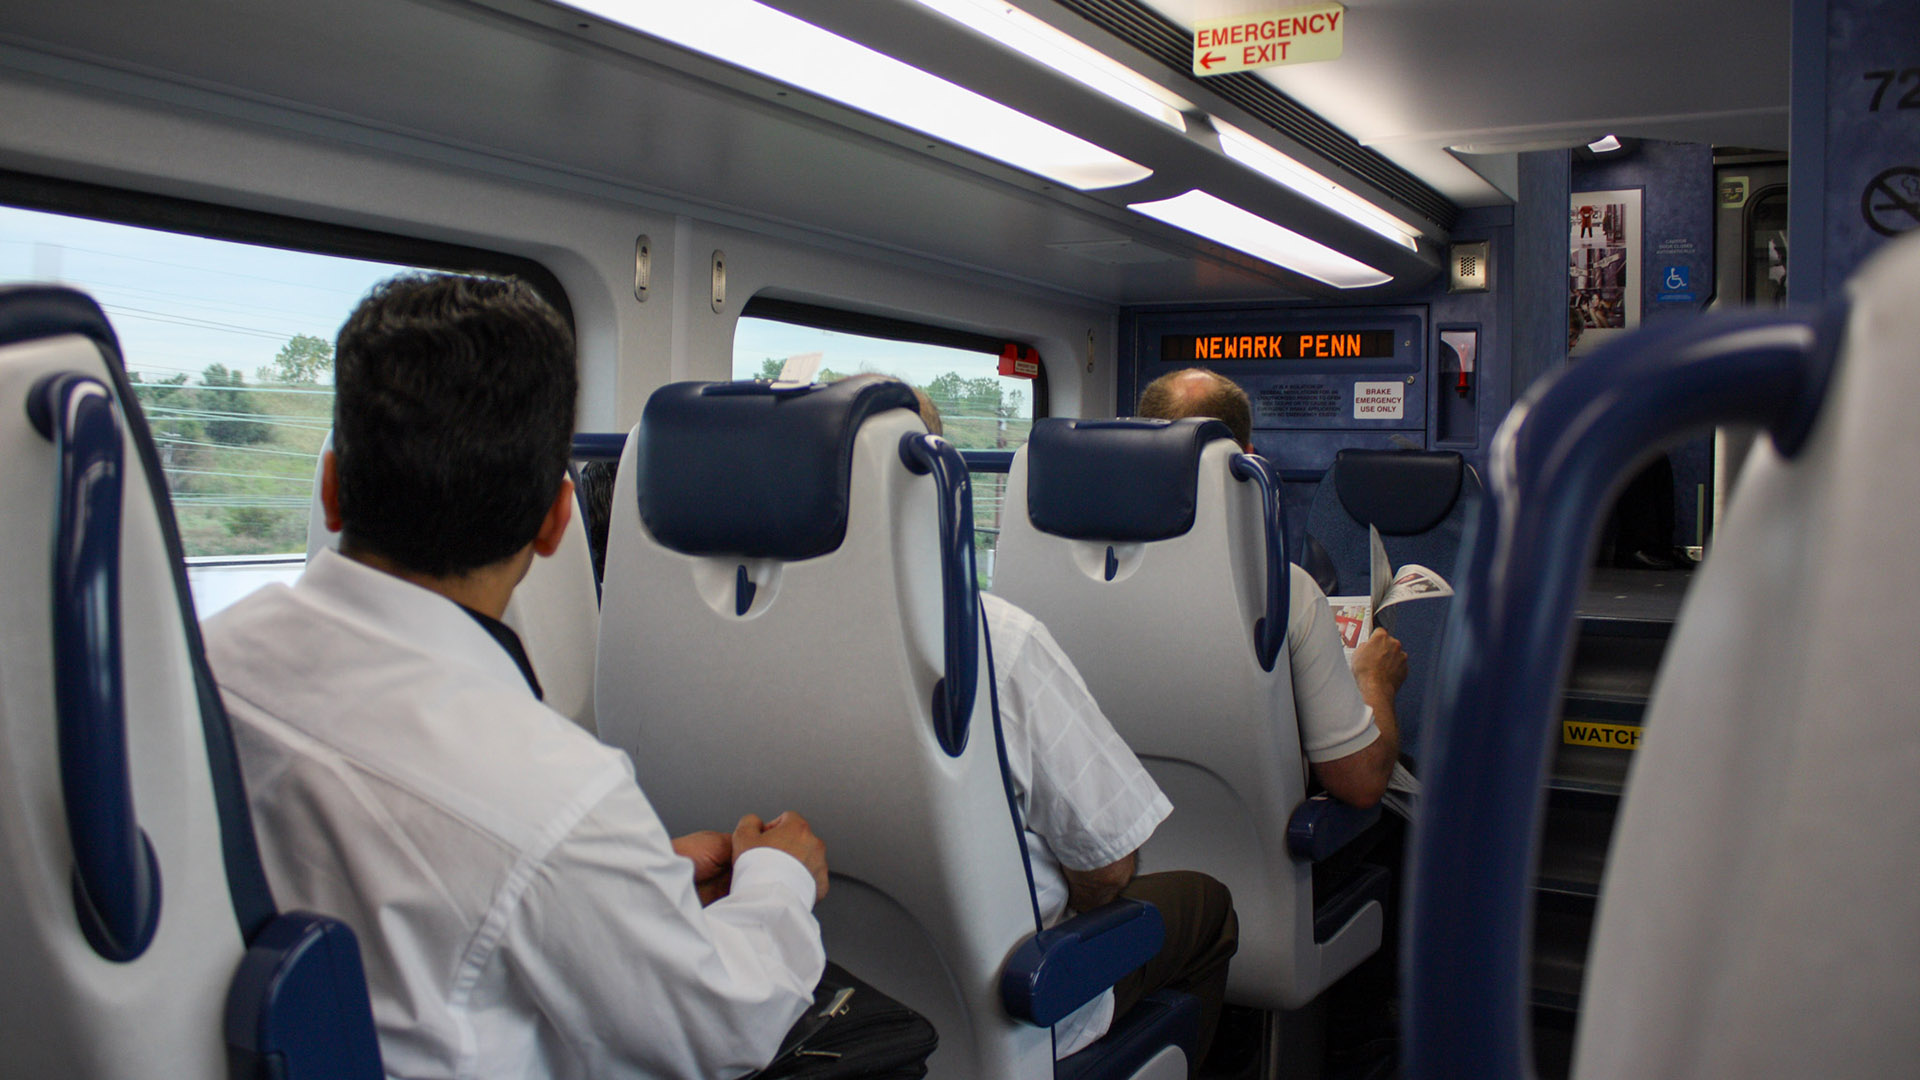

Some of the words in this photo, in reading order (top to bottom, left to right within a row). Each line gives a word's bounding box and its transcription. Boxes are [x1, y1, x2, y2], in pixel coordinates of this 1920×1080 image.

[1198, 11, 1340, 48] EMERGENCY
[1243, 41, 1291, 65] EXIT
[1195, 335, 1283, 359] NEWARK
[1299, 334, 1361, 357] PENN
[1568, 725, 1643, 745] WATCH
